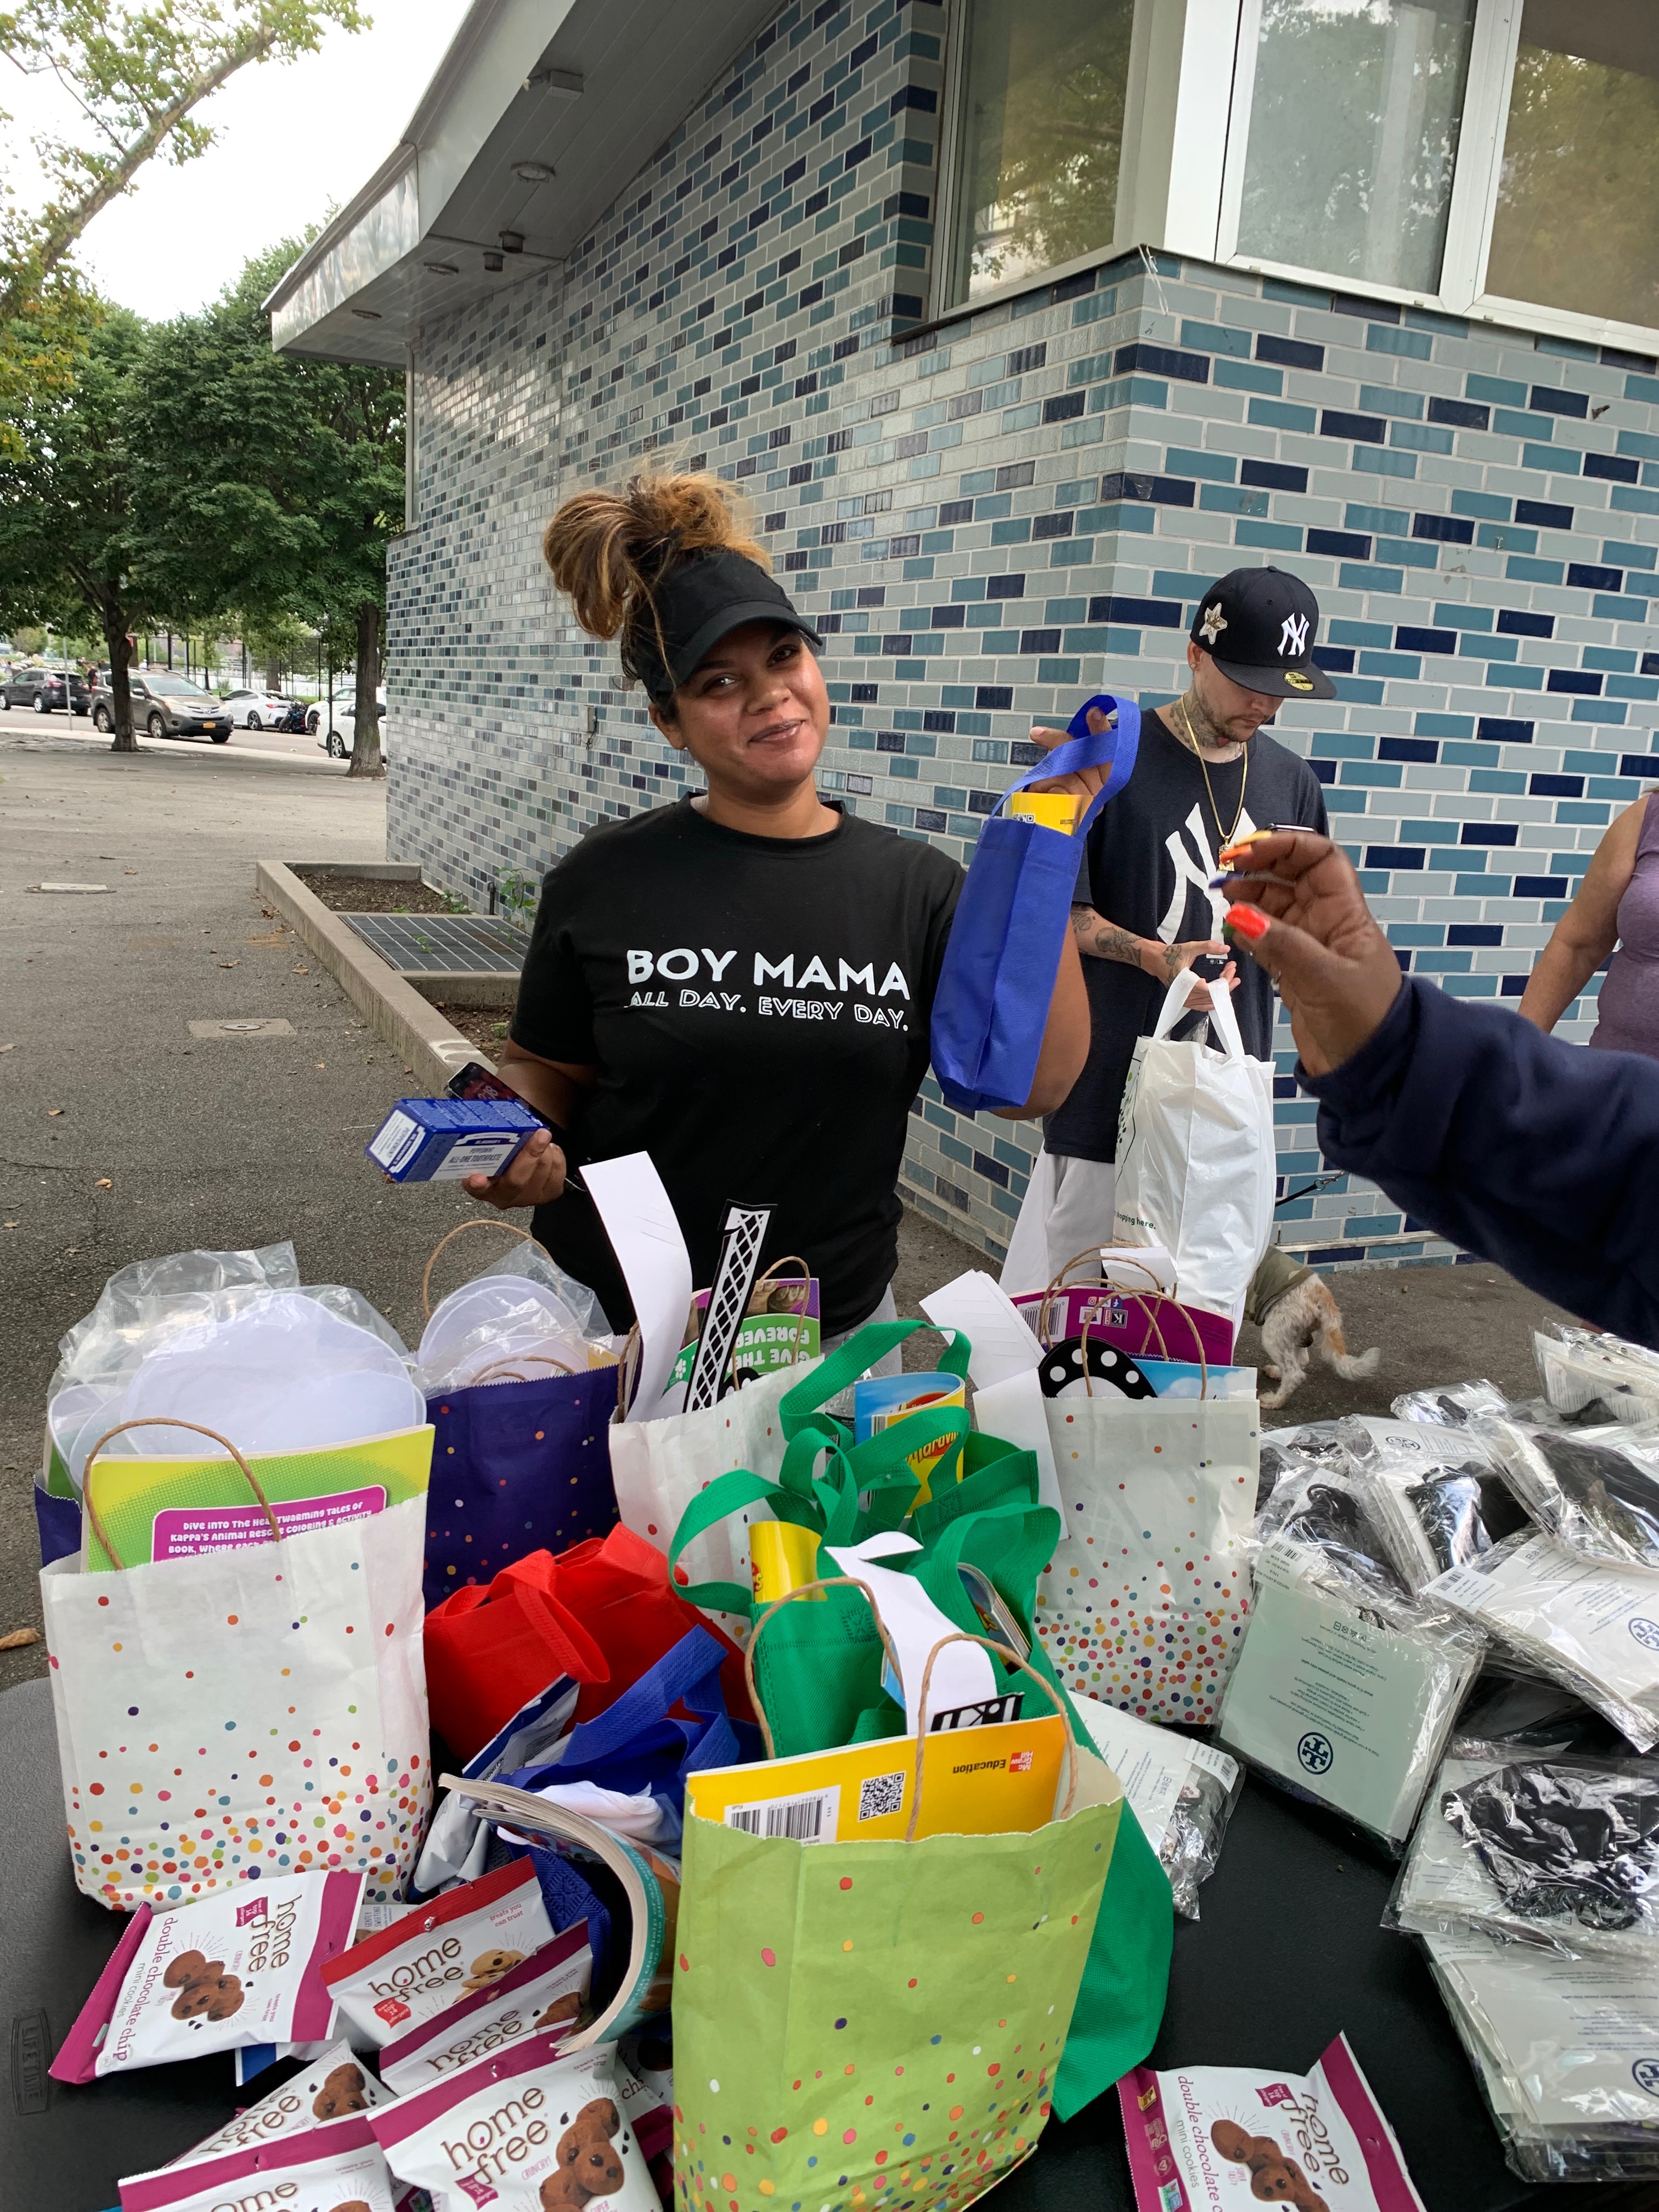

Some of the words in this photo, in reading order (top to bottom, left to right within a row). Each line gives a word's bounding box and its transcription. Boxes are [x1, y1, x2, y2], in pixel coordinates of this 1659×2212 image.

[1278, 612, 1310, 657] NY
[627, 949, 737, 984] BOY
[754, 952, 911, 1000] MAMA
[624, 991, 669, 1008] ALL
[679, 990, 747, 1013] DAY.
[758, 997, 844, 1020] EVERY
[854, 1004, 909, 1031] DAY.
[1116, 1211, 1135, 1225] shopping
[1136, 1216, 1156, 1230] here.
[1113, 1312, 1124, 1324] K
[953, 1759, 1006, 1774] Education
[1020, 1750, 1033, 1758] Hill
[270, 1894, 302, 1968] home
[490, 1909, 509, 1922] treats
[510, 1902, 522, 1914] you
[494, 1916, 508, 1927] can
[508, 1910, 524, 1922] trust
[153, 1917, 178, 1963] double
[248, 1920, 276, 1973] free
[132, 1962, 145, 1984] mini
[368, 1937, 461, 1996] home
[398, 1966, 464, 2002] free
[116, 1985, 136, 2019] cookies
[126, 1964, 163, 2025] chocolate
[21, 2021, 44, 2103] LIFETIME
[112, 2027, 137, 2061] chip
[425, 2010, 520, 2072] home
[440, 2087, 545, 2171] home
[1177, 2075, 1199, 2124] double
[1192, 2121, 1221, 2201] chocolate
[1280, 2103, 1321, 2173] free
[1301, 2092, 1350, 2185] home
[477, 2120, 549, 2185] free
[521, 2155, 552, 2181] CRUNCHY!
[1176, 2119, 1188, 2145] mini
[1183, 2145, 1200, 2188] cookies
